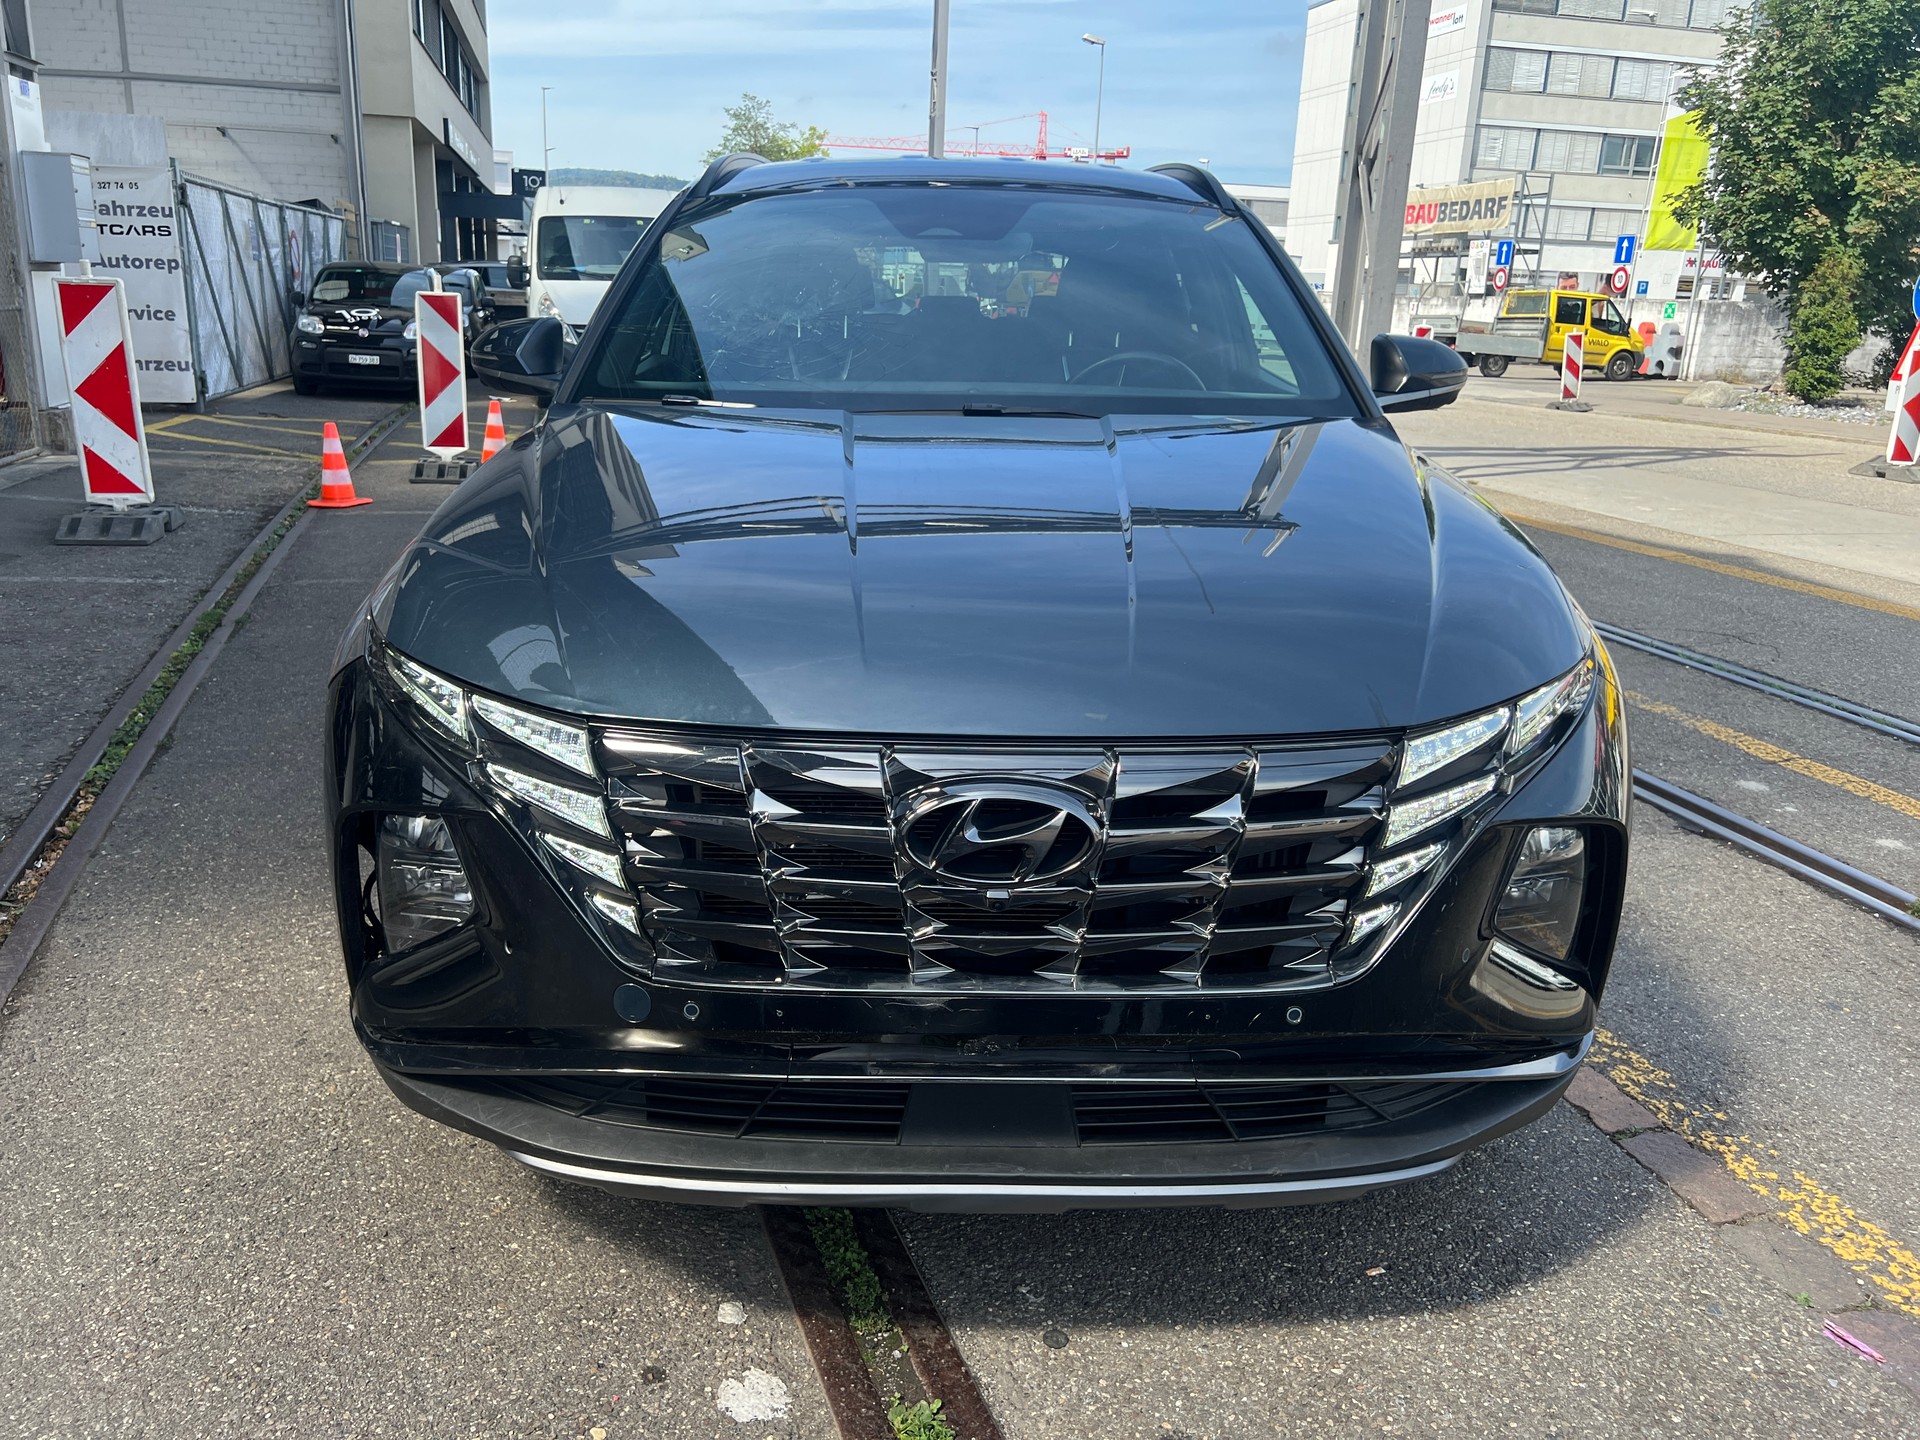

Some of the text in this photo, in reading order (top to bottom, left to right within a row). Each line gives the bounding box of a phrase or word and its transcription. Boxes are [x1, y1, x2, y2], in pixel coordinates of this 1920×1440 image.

[97, 181, 139, 190] 327 74 05
[94, 200, 174, 219] ahrzeu
[1404, 196, 1509, 225] BAUBEDARF
[1638, 282, 1647, 293] P
[1588, 338, 1610, 347] WALO
